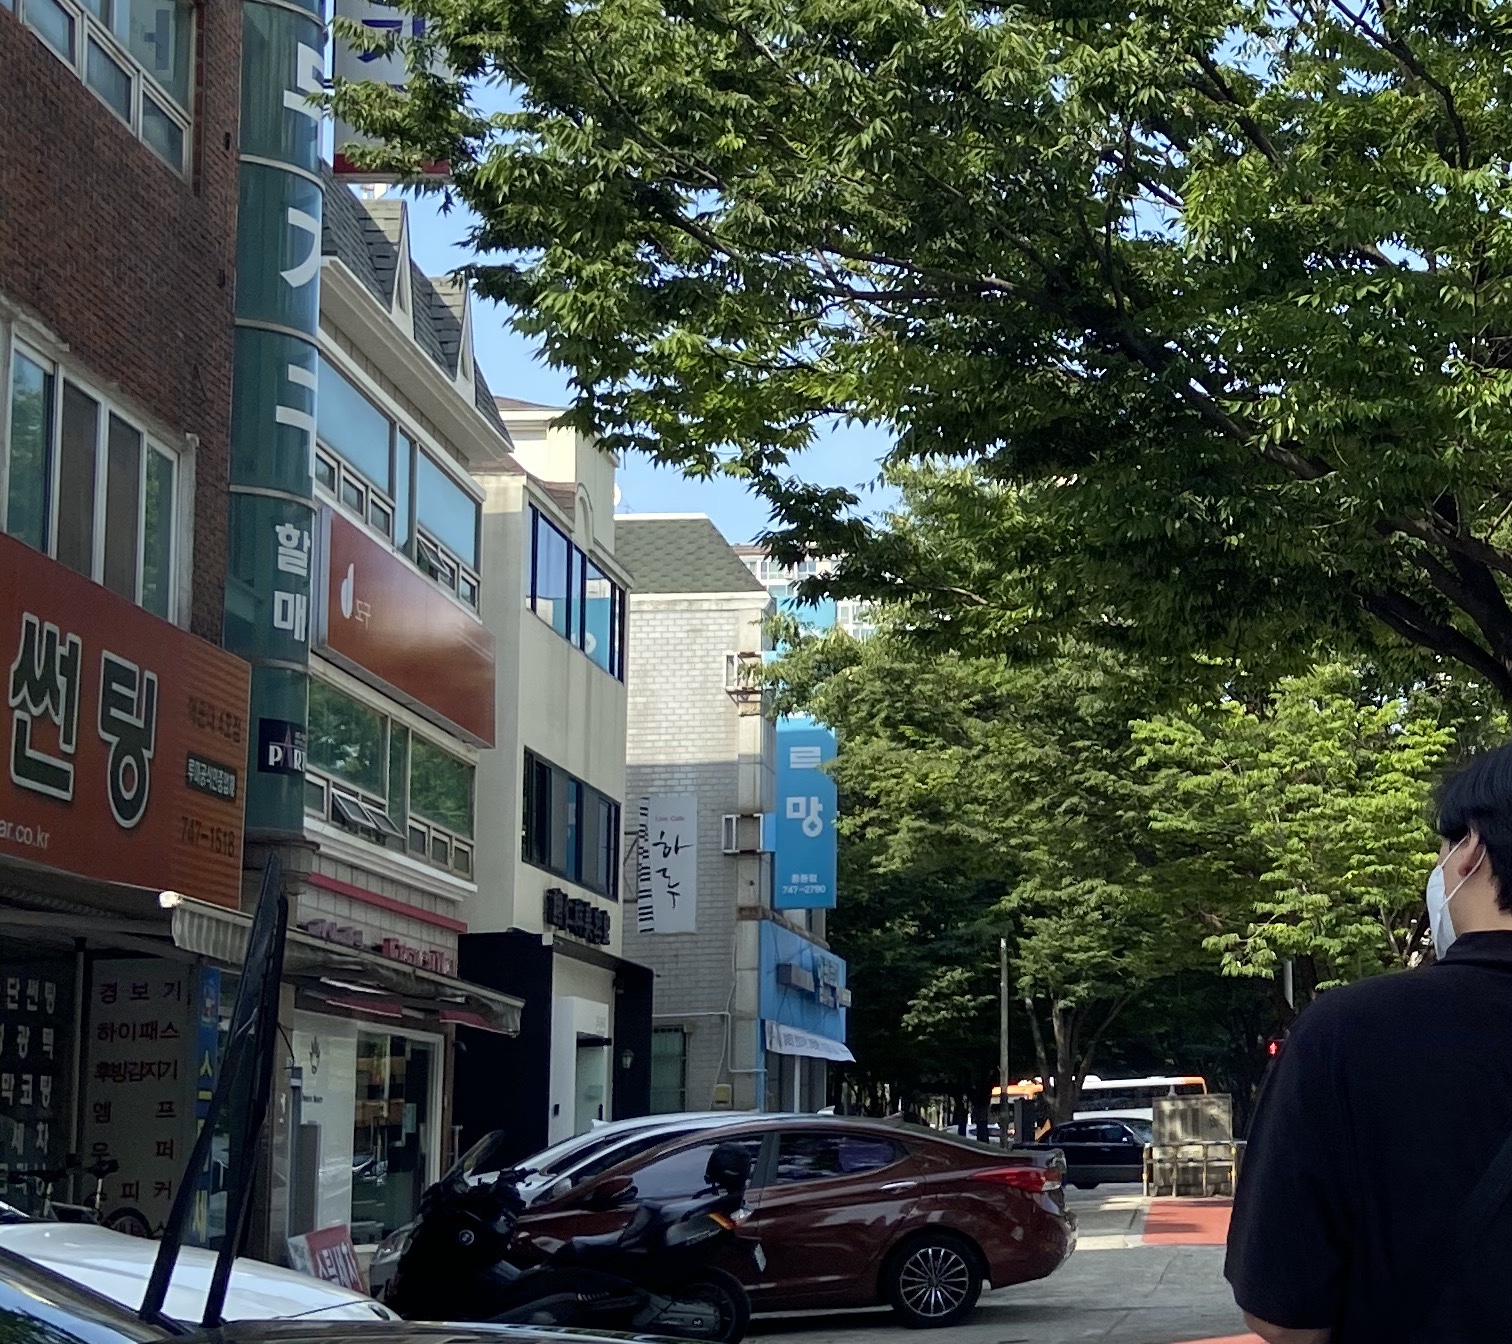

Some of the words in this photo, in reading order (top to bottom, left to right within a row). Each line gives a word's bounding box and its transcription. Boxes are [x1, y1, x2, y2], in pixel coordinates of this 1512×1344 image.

[273, 523, 310, 641] 할매
[9, 611, 158, 829] 썬팅
[97, 1020, 180, 1042] 하이패스
